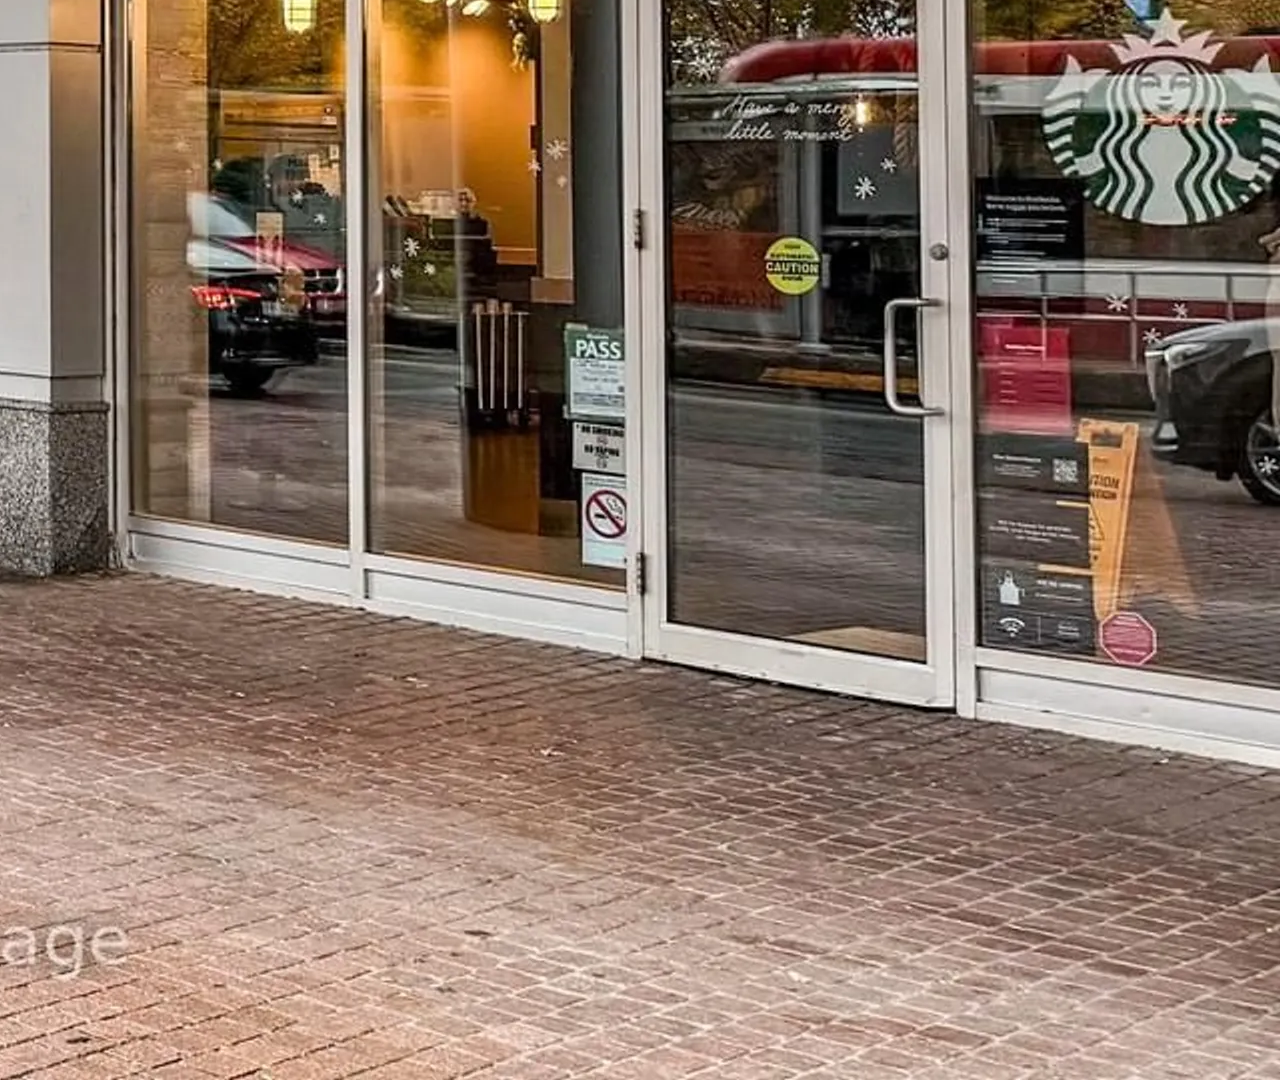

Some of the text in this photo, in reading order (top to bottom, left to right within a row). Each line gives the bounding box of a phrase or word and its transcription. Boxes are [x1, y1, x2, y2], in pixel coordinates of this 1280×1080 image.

[722, 94, 780, 118] Have
[784, 102, 800, 115] a
[723, 120, 855, 142] little moment
[765, 262, 819, 274] CAUTION
[575, 339, 621, 360] PASS
